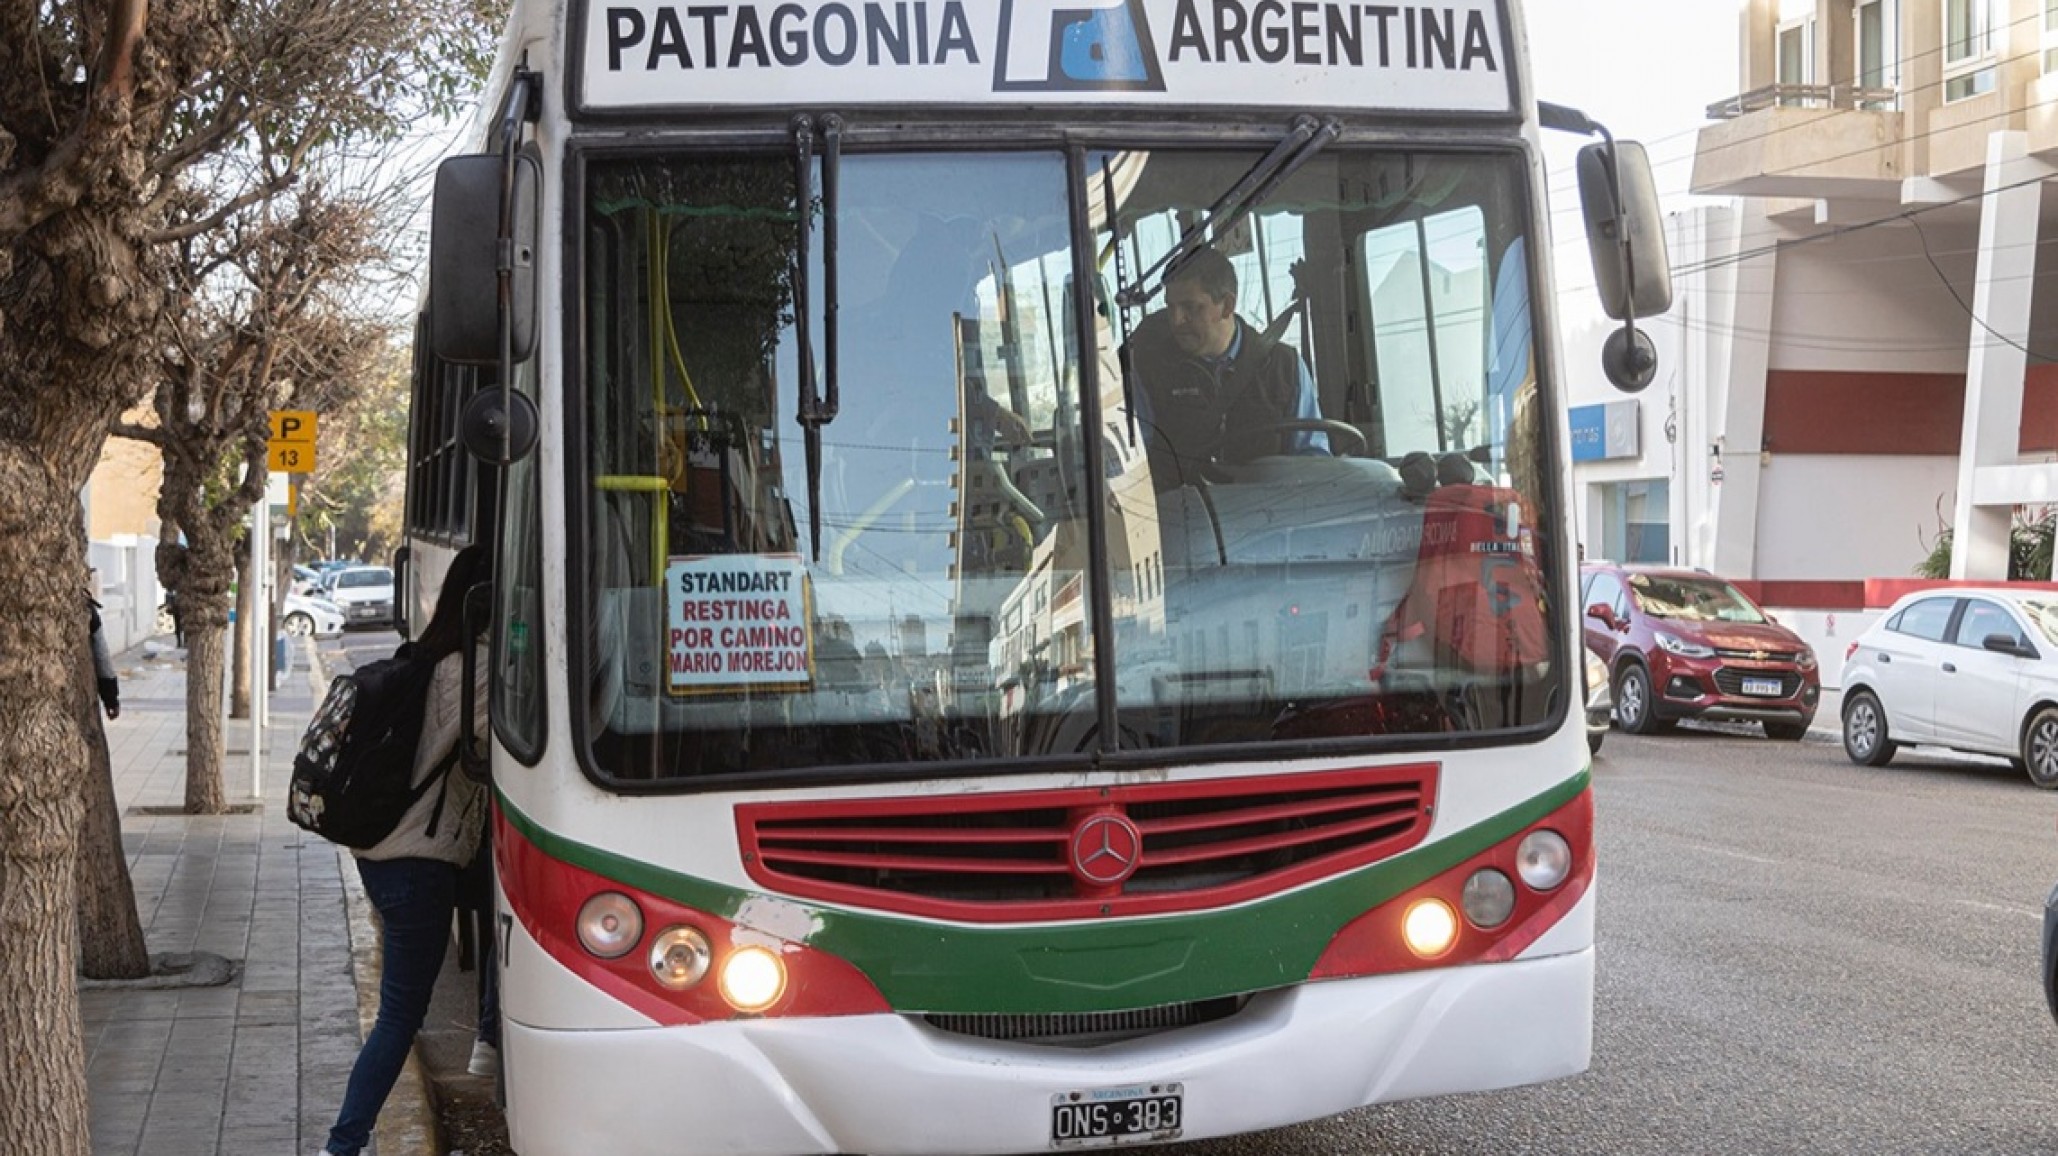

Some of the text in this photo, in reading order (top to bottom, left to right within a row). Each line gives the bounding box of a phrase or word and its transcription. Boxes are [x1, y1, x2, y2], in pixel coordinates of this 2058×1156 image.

[607, 1, 981, 71] PATAGONIA
[1168, 0, 1499, 72] ARGENTINA
[281, 418, 300, 438] P
[279, 450, 297, 467] 13
[681, 571, 792, 594] STANDART
[682, 600, 791, 622] RESTINGA
[671, 626, 805, 649] POR CAMINO
[670, 650, 808, 674] MARIO MOREJON
